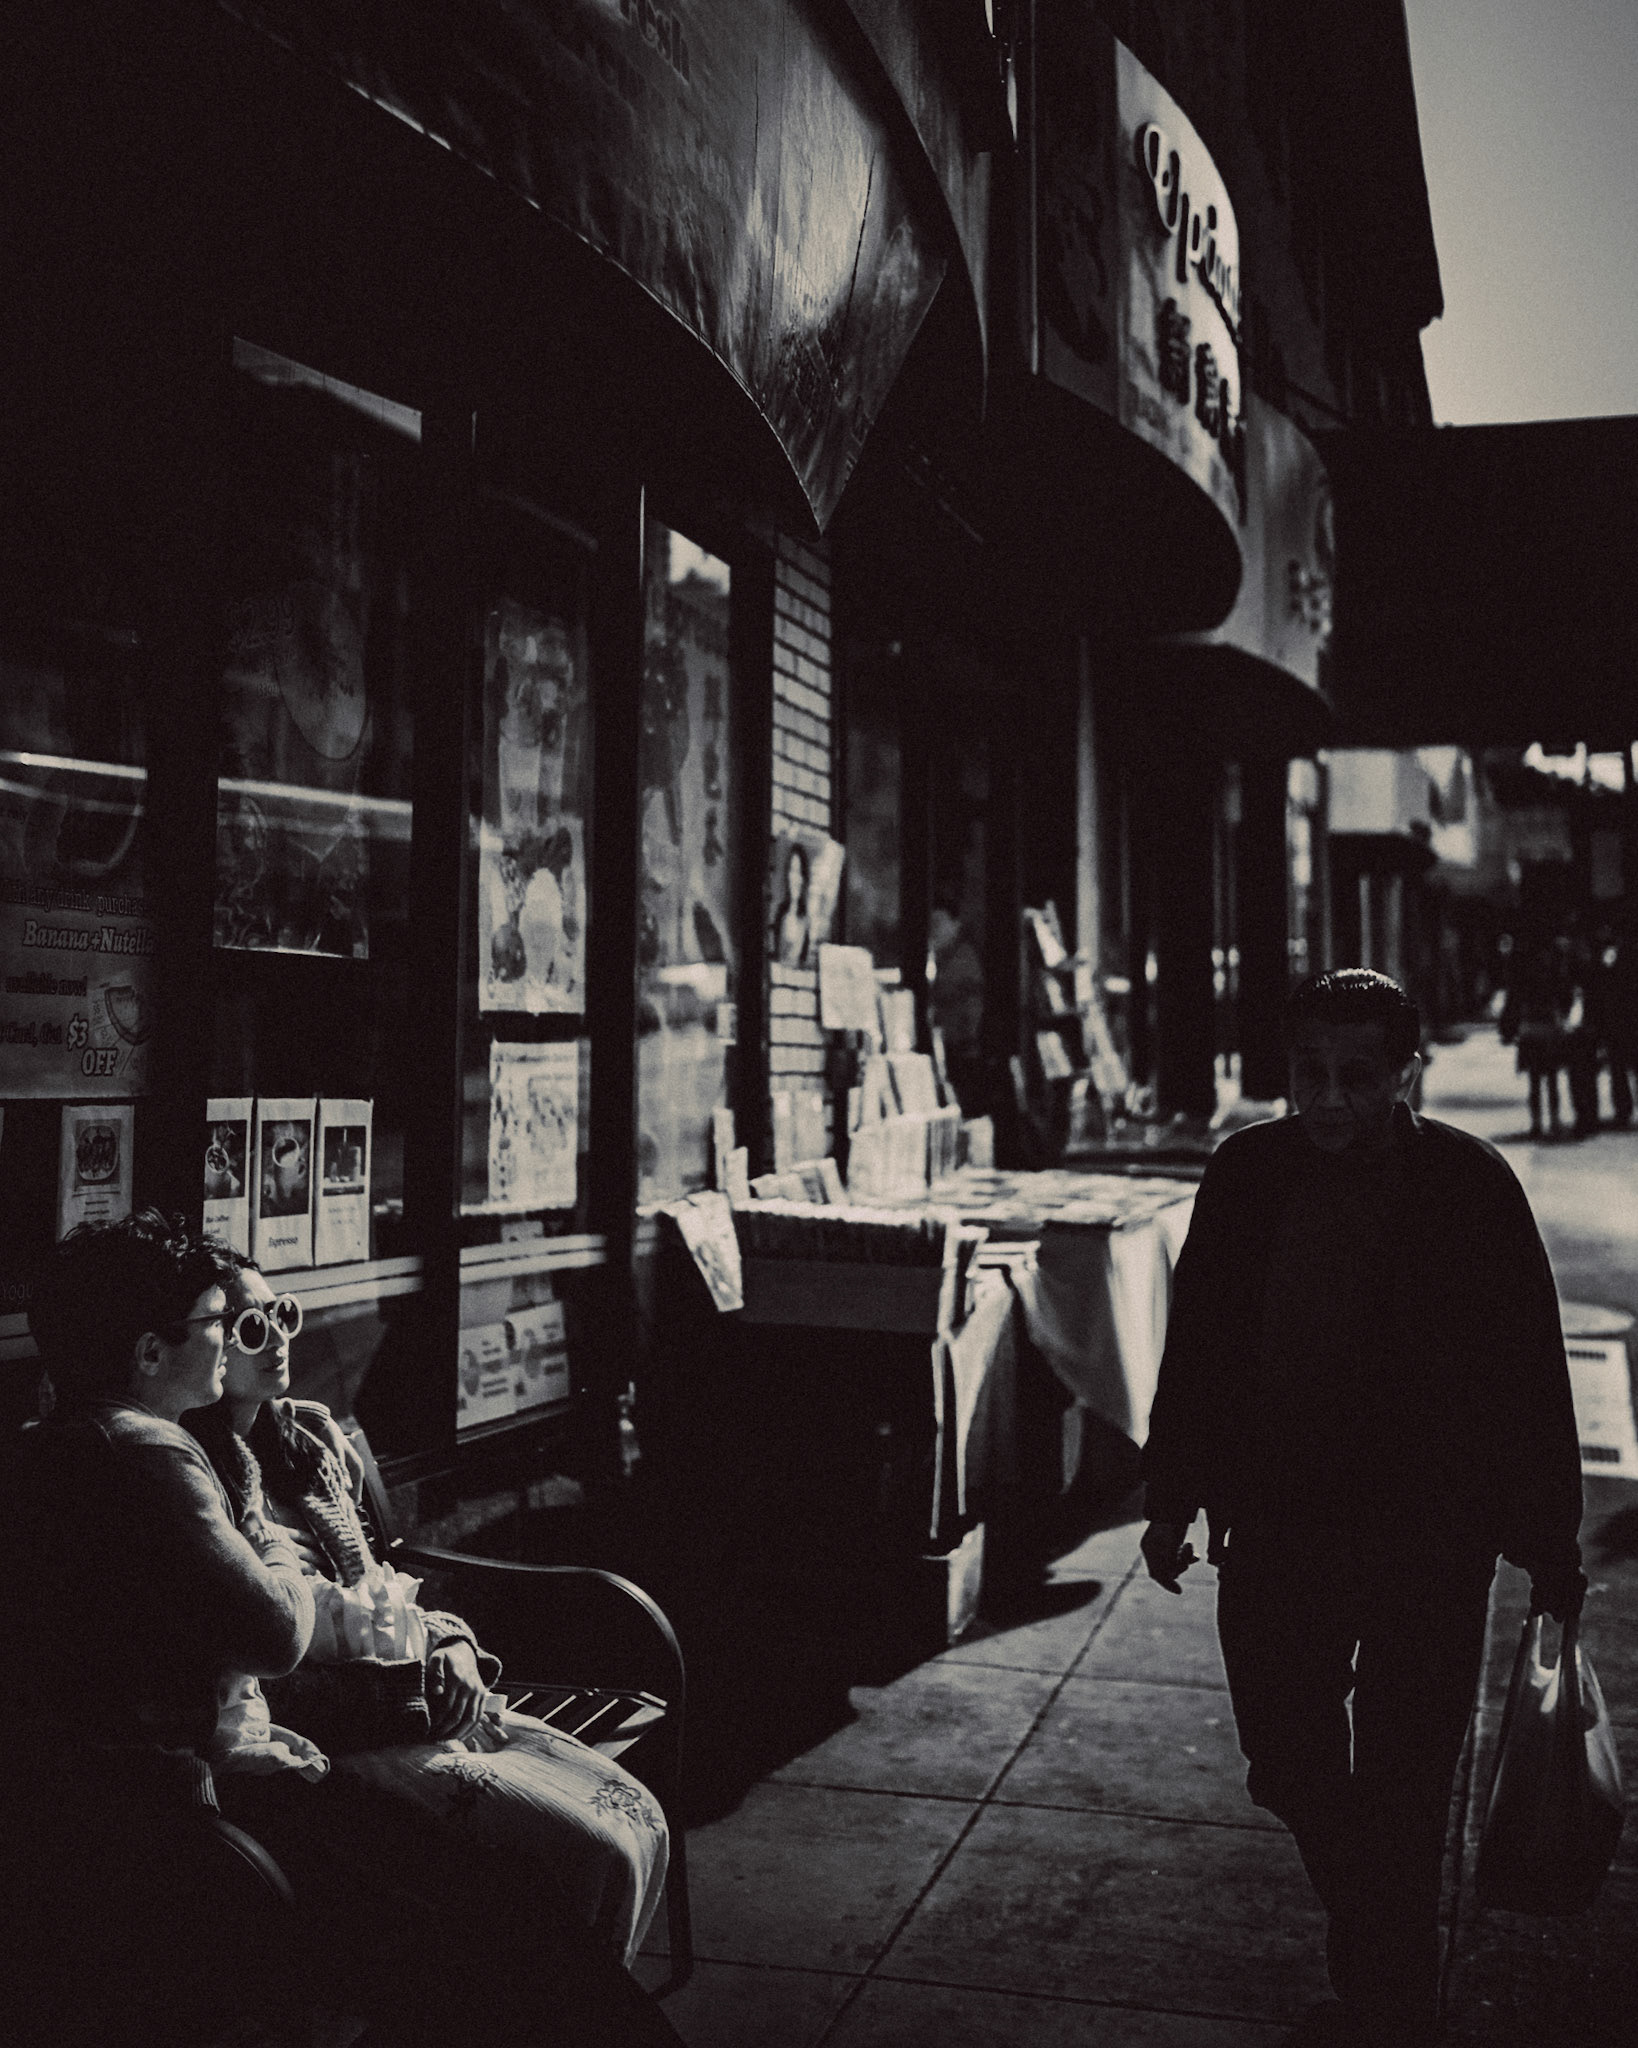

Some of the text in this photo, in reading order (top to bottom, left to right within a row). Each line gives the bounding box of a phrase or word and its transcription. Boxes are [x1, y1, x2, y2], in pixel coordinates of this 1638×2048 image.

[30, 887, 55, 913] any
[57, 888, 91, 912] drink
[67, 1012, 89, 1052] $3
[81, 1046, 118, 1077] OFF
